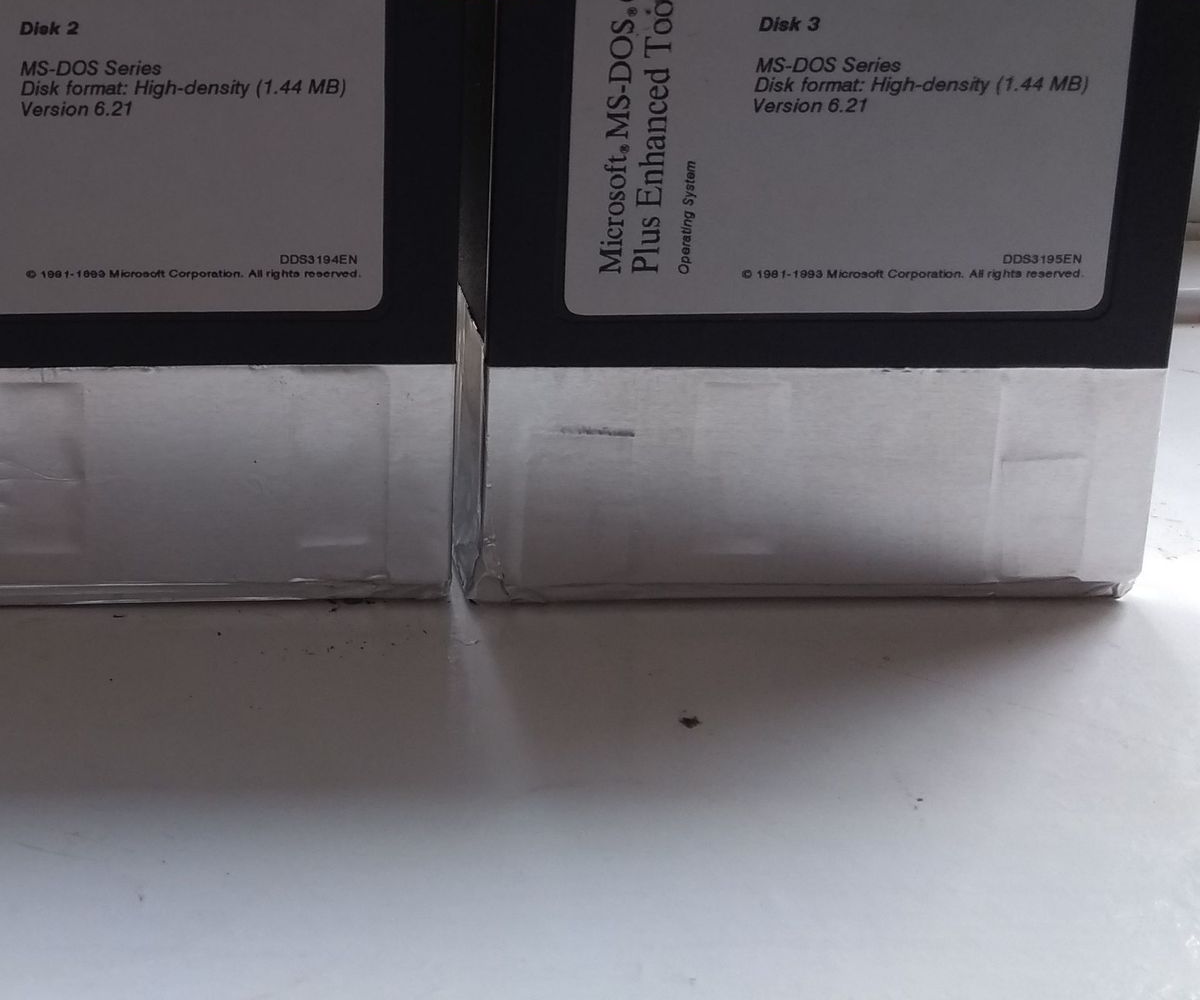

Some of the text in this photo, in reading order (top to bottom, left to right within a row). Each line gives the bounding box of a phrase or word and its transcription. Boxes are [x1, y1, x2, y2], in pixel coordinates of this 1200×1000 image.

[18, 20, 62, 36] Disk
[758, 15, 803, 33] Disk
[19, 59, 163, 77] MS-DOS Series
[755, 56, 902, 74] MS-DOS Series
[20, 77, 347, 100] Disk format: High-density (1.44 MB)
[753, 74, 1089, 97] Disk format: High-density (1.44 MB)
[20, 100, 133, 118] Version 6.21
[753, 96, 868, 114] Version 6.21
[635, 67, 672, 208] Enhanced
[677, 160, 698, 275] Operating System
[630, 216, 661, 275] Plus
[279, 253, 358, 265] DDS3194EN
[1002, 253, 1083, 265] DDS3195EN
[108, 268, 166, 279] Microsoft
[168, 268, 245, 281] Corporation.
[247, 268, 264, 279] All
[265, 268, 301, 281] rights
[826, 268, 885, 280] Microsoft
[887, 268, 964, 281] Corporation.
[968, 268, 985, 279] All
[986, 268, 1023, 281] rights
[1025, 268, 1081, 279] reserved.
